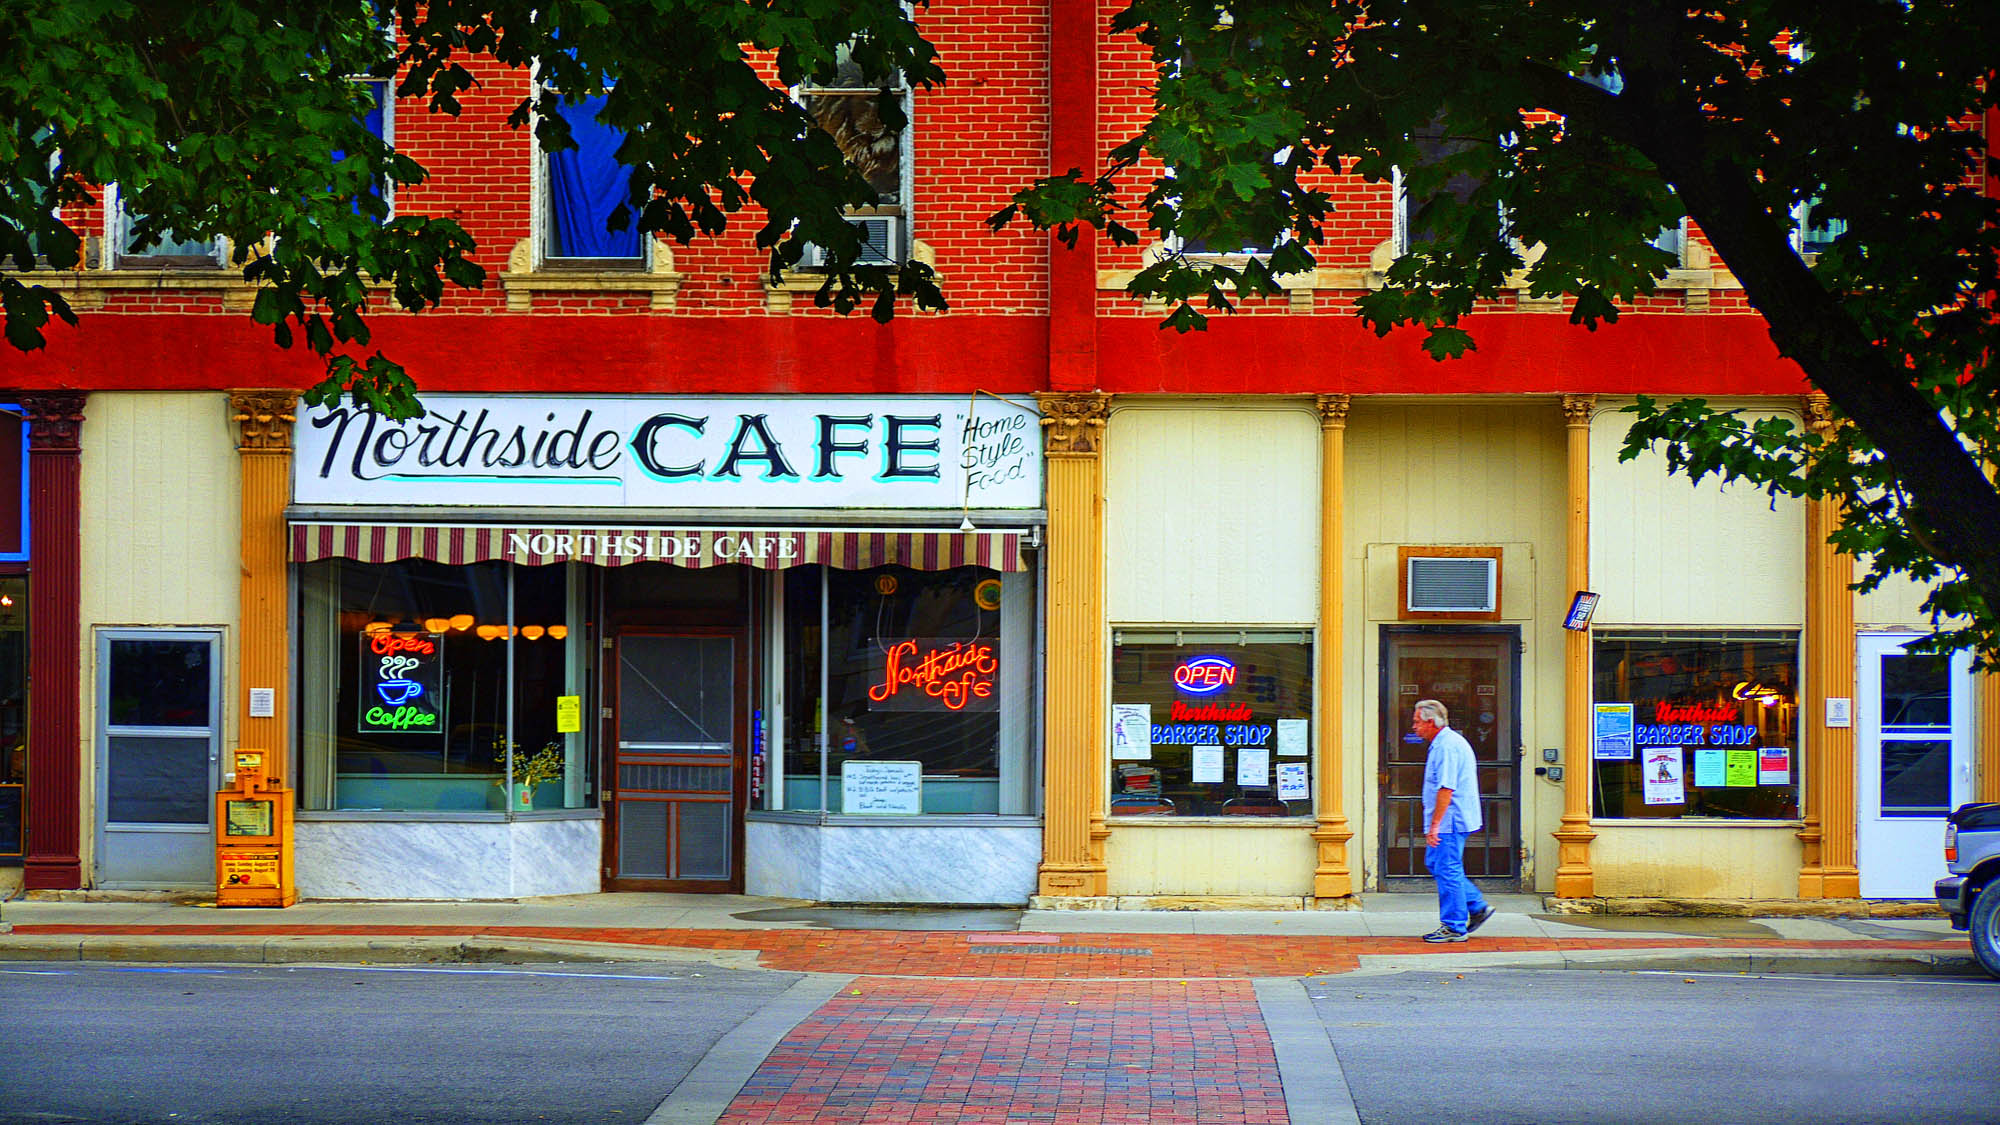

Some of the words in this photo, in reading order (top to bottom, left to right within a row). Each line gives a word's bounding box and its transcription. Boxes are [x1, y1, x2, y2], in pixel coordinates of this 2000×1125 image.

[312, 408, 622, 480] Northside
[627, 413, 940, 484] CAFE
[960, 432, 1024, 469] Style
[508, 533, 701, 559] NORTHSIDE
[713, 536, 798, 560] CAFE
[371, 632, 435, 656] Open
[1174, 664, 1237, 685] OPEN
[366, 706, 436, 729] Coffee
[1171, 700, 1253, 721] Northside
[1656, 701, 1738, 722] Northside
[1151, 724, 1220, 745] BARBER
[1224, 724, 1272, 745] SHOP
[1635, 724, 1705, 745] BARBER
[1709, 724, 1757, 745] SHOP
